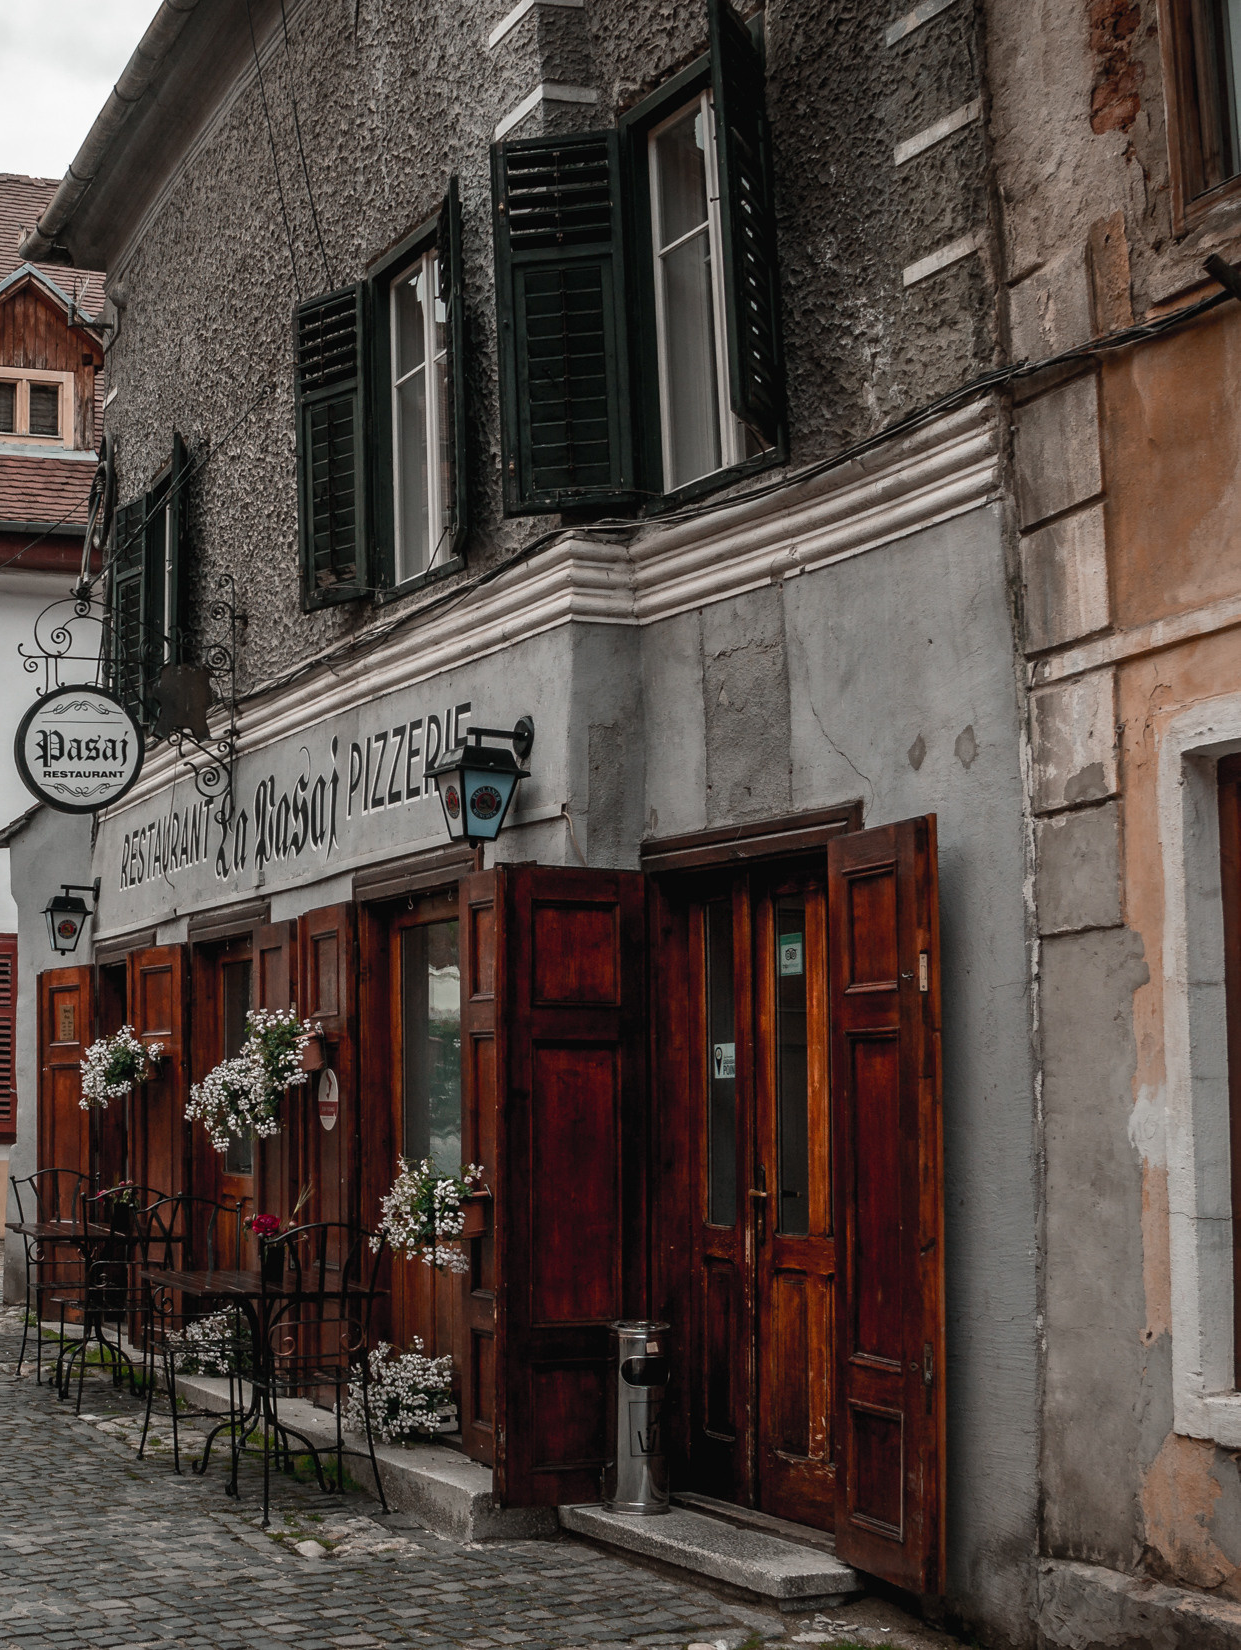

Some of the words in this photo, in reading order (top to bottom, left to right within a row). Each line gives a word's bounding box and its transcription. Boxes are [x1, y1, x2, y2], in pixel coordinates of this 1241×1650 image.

[34, 729, 129, 768] Pasaj
[119, 798, 215, 892] RESTAURANT
[215, 787, 249, 882] La
[254, 735, 339, 870] Pasaj
